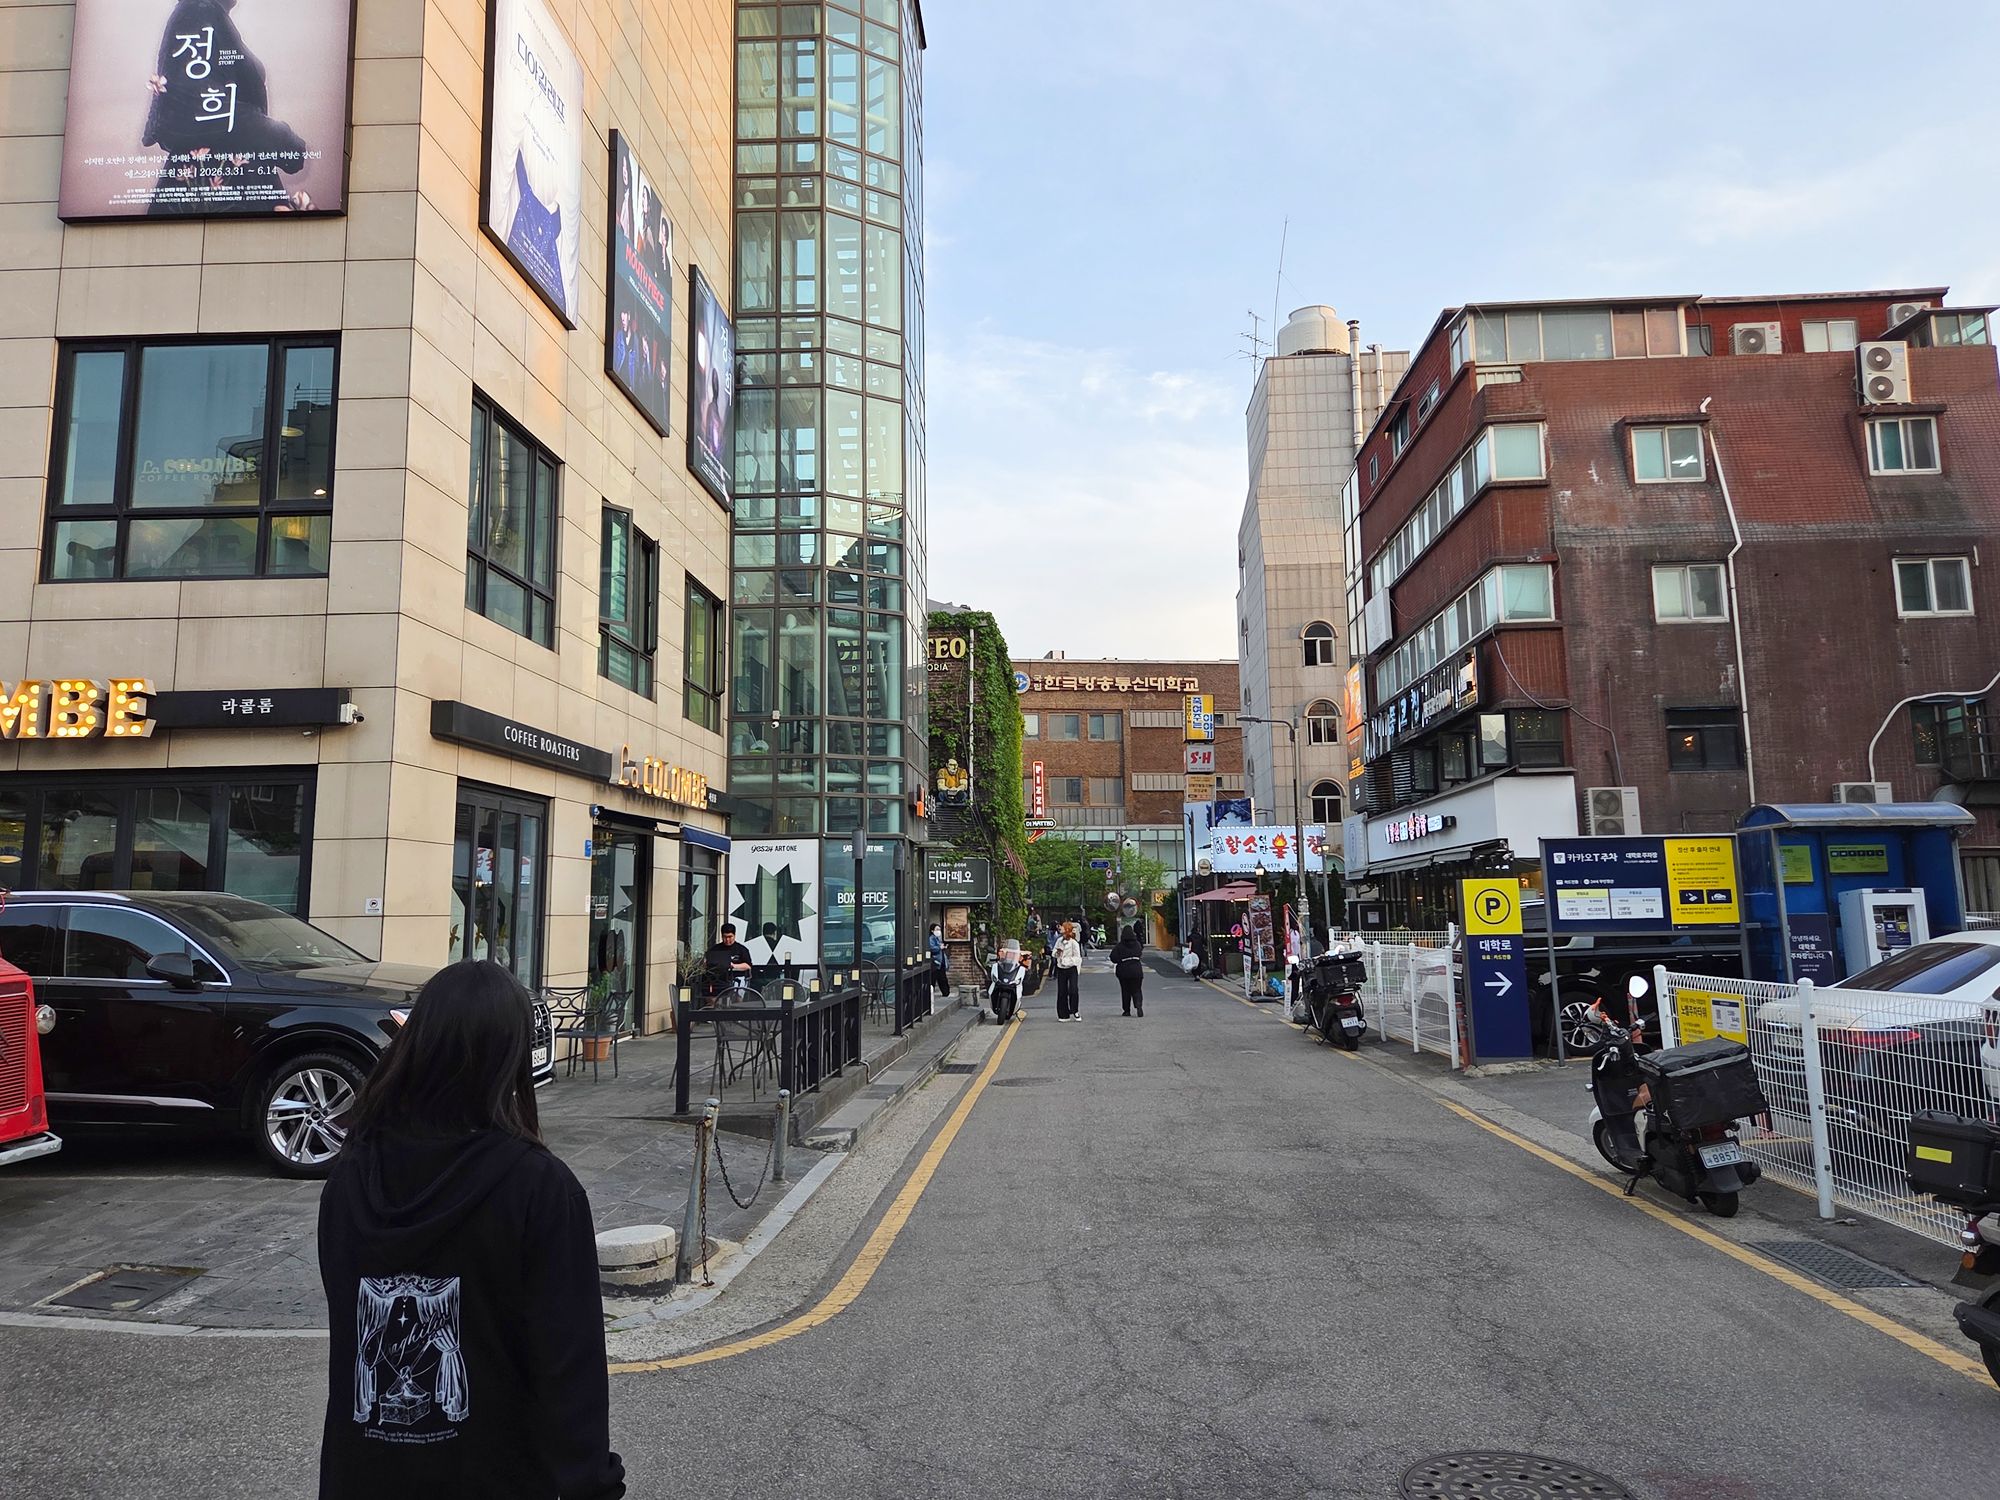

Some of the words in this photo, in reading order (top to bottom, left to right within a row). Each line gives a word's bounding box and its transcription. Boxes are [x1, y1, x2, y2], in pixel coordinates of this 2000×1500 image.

[200, 167, 244, 176] 2026.3.31
[257, 166, 277, 175] 6.14
[626, 242, 665, 311] MOUTHPIECE
[142, 460, 160, 474] La
[164, 457, 257, 474] COLOMBE
[138, 474, 187, 483] COFFEE
[194, 472, 257, 482] ROASTERS
[1043, 675, 1200, 692] 한국방송통신대학교
[221, 698, 274, 715] 라콜롬
[1192, 696, 1202, 729] 죽여주는
[1203, 714, 1213, 739] 이야기
[504, 725, 537, 749] COFFEE
[540, 736, 580, 762] ROASTERS
[642, 755, 709, 810] COLOMBE
[1225, 835, 1258, 855] 황소
[1600, 852, 1618, 862] 주차
[837, 892, 856, 904] BOX
[862, 892, 889, 904] FFICE
[1485, 897, 1501, 916] P
[1479, 939, 1512, 952] 대학로
